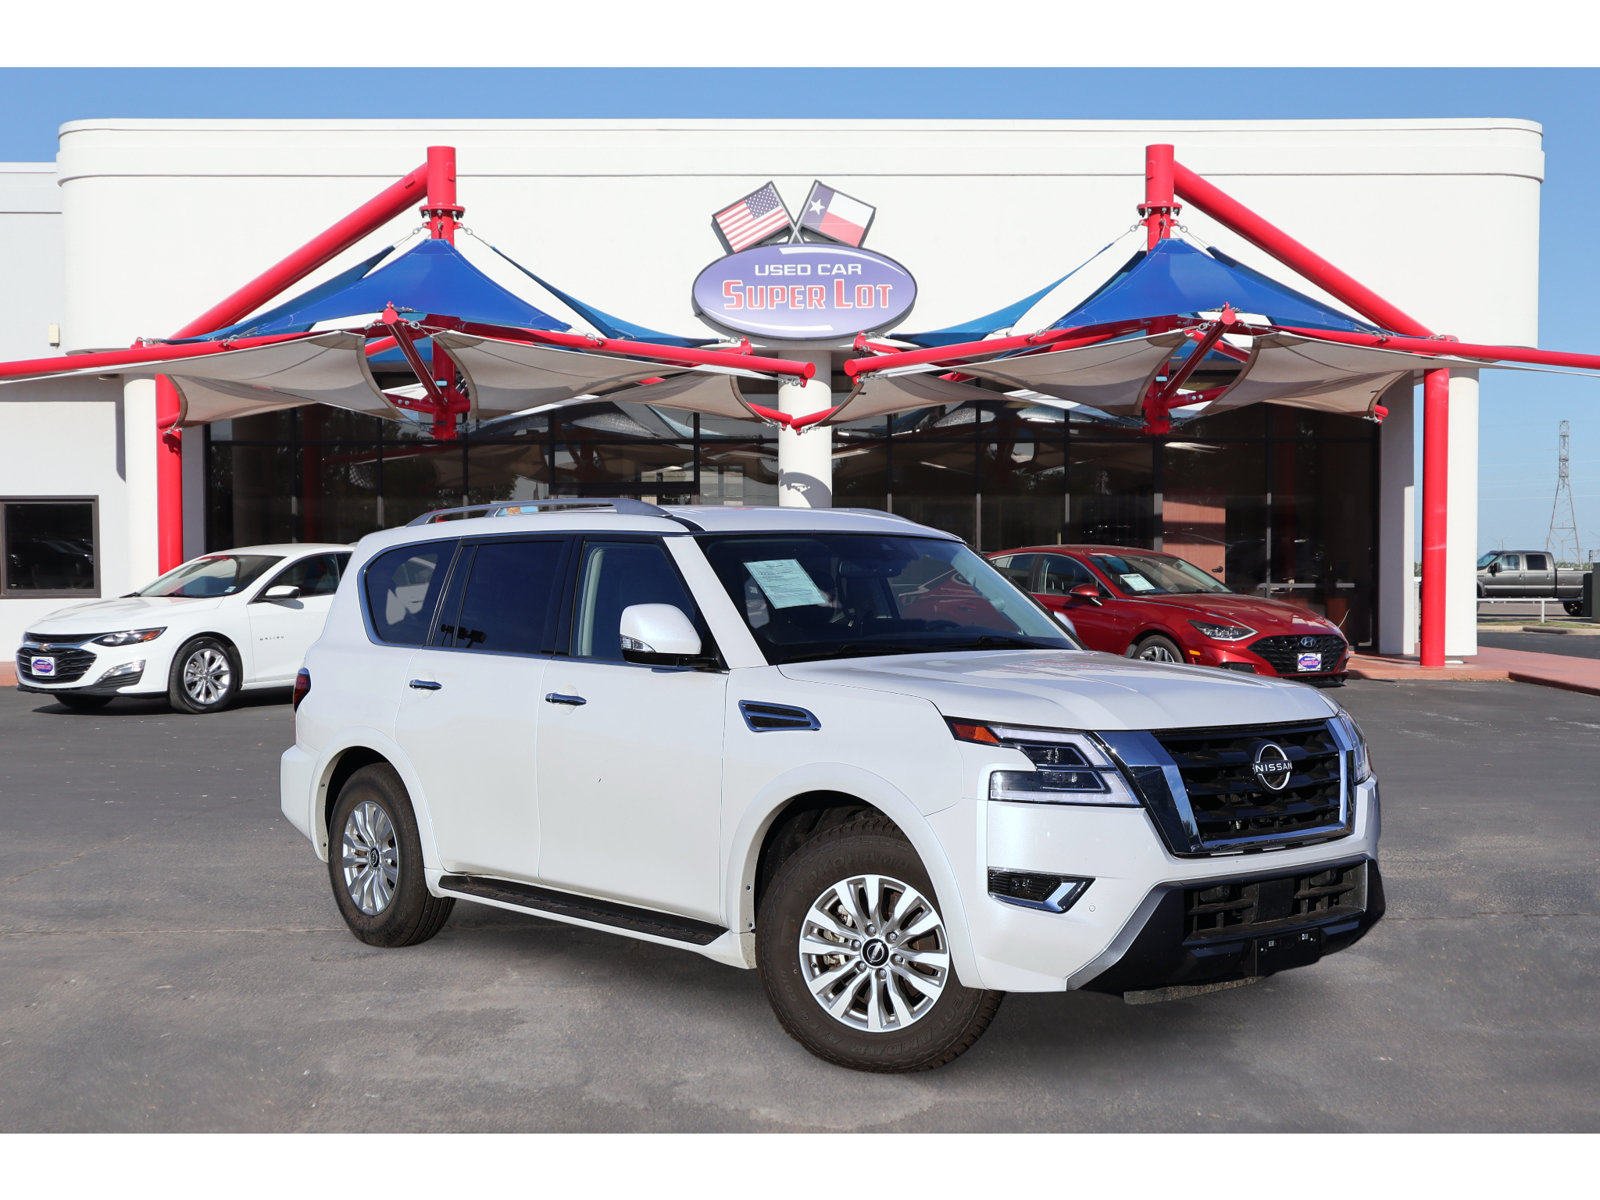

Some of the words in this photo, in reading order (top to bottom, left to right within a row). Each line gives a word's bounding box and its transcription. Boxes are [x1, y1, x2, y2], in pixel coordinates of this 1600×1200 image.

[754, 264, 811, 276] USED
[817, 263, 862, 275] CAR
[722, 280, 826, 310] SUPER
[833, 279, 893, 309] LOT
[1255, 762, 1293, 773] NISSAN
